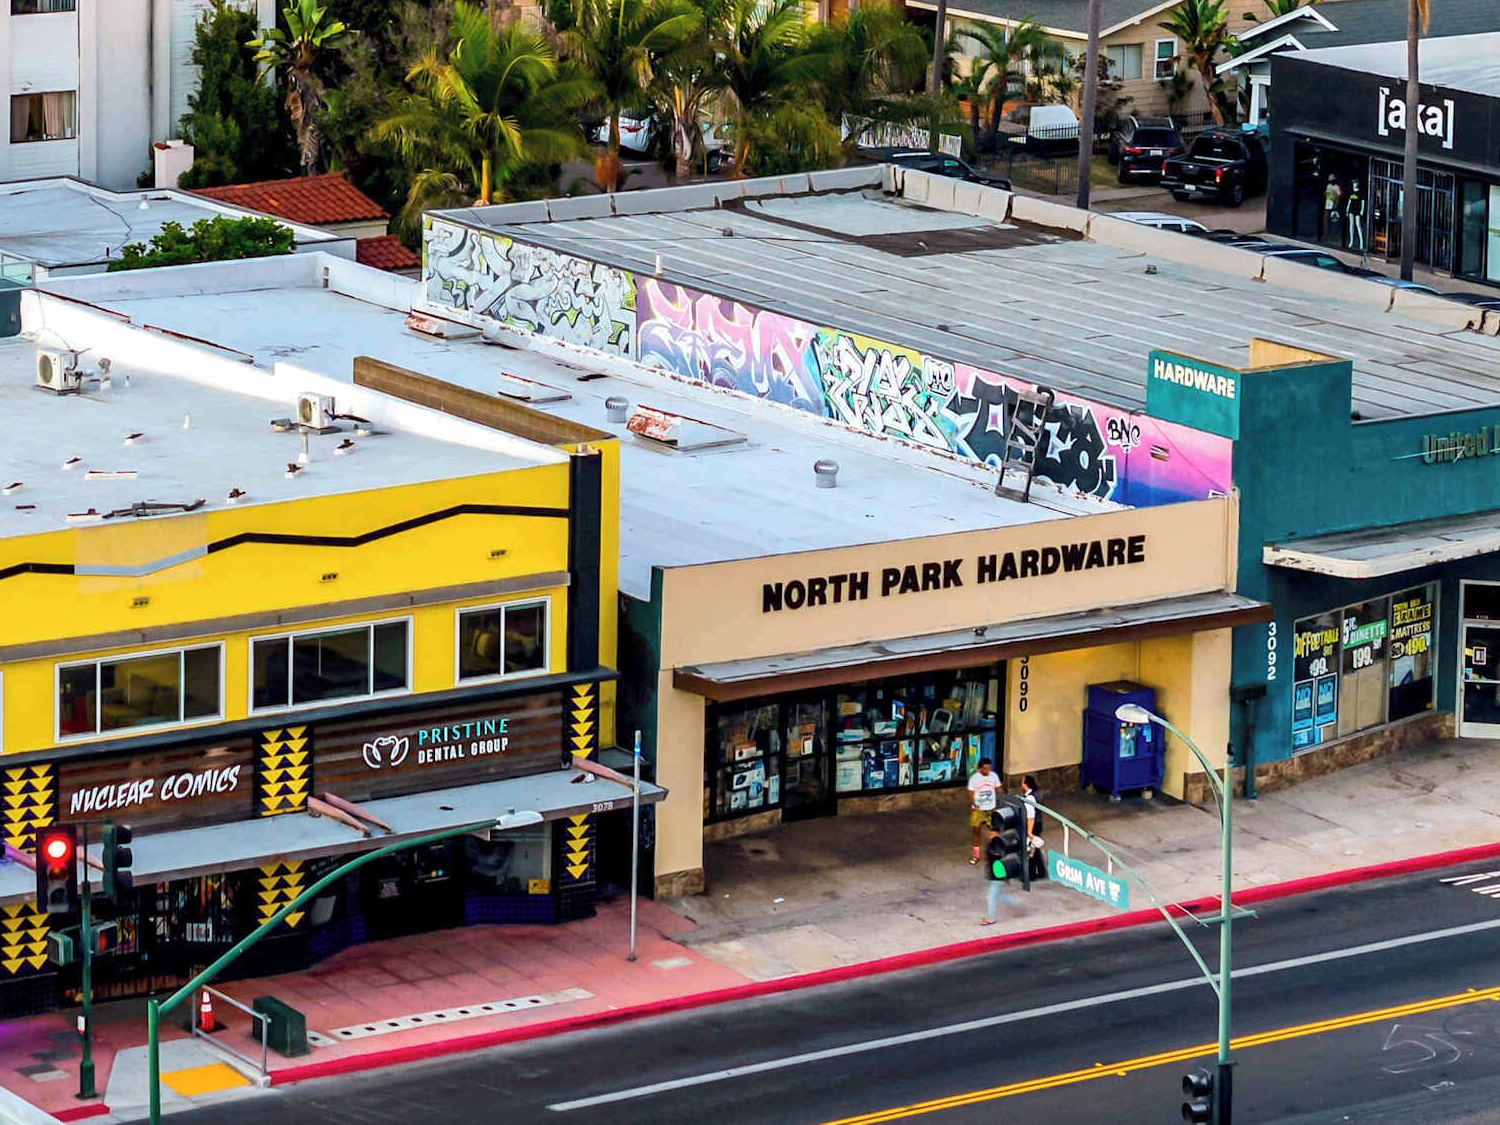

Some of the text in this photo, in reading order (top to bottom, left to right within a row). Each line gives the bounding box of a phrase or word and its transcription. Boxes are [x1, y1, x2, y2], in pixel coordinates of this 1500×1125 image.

[1153, 358, 1236, 400] HARDWARE
[762, 535, 1147, 613] NORTH PARK HARDWARE
[1267, 621, 1277, 681] 3092
[417, 737, 509, 764] DENTAL GROUP
[418, 718, 510, 746] PRISTINE
[69, 764, 241, 815] NUCLEAR COMICS
